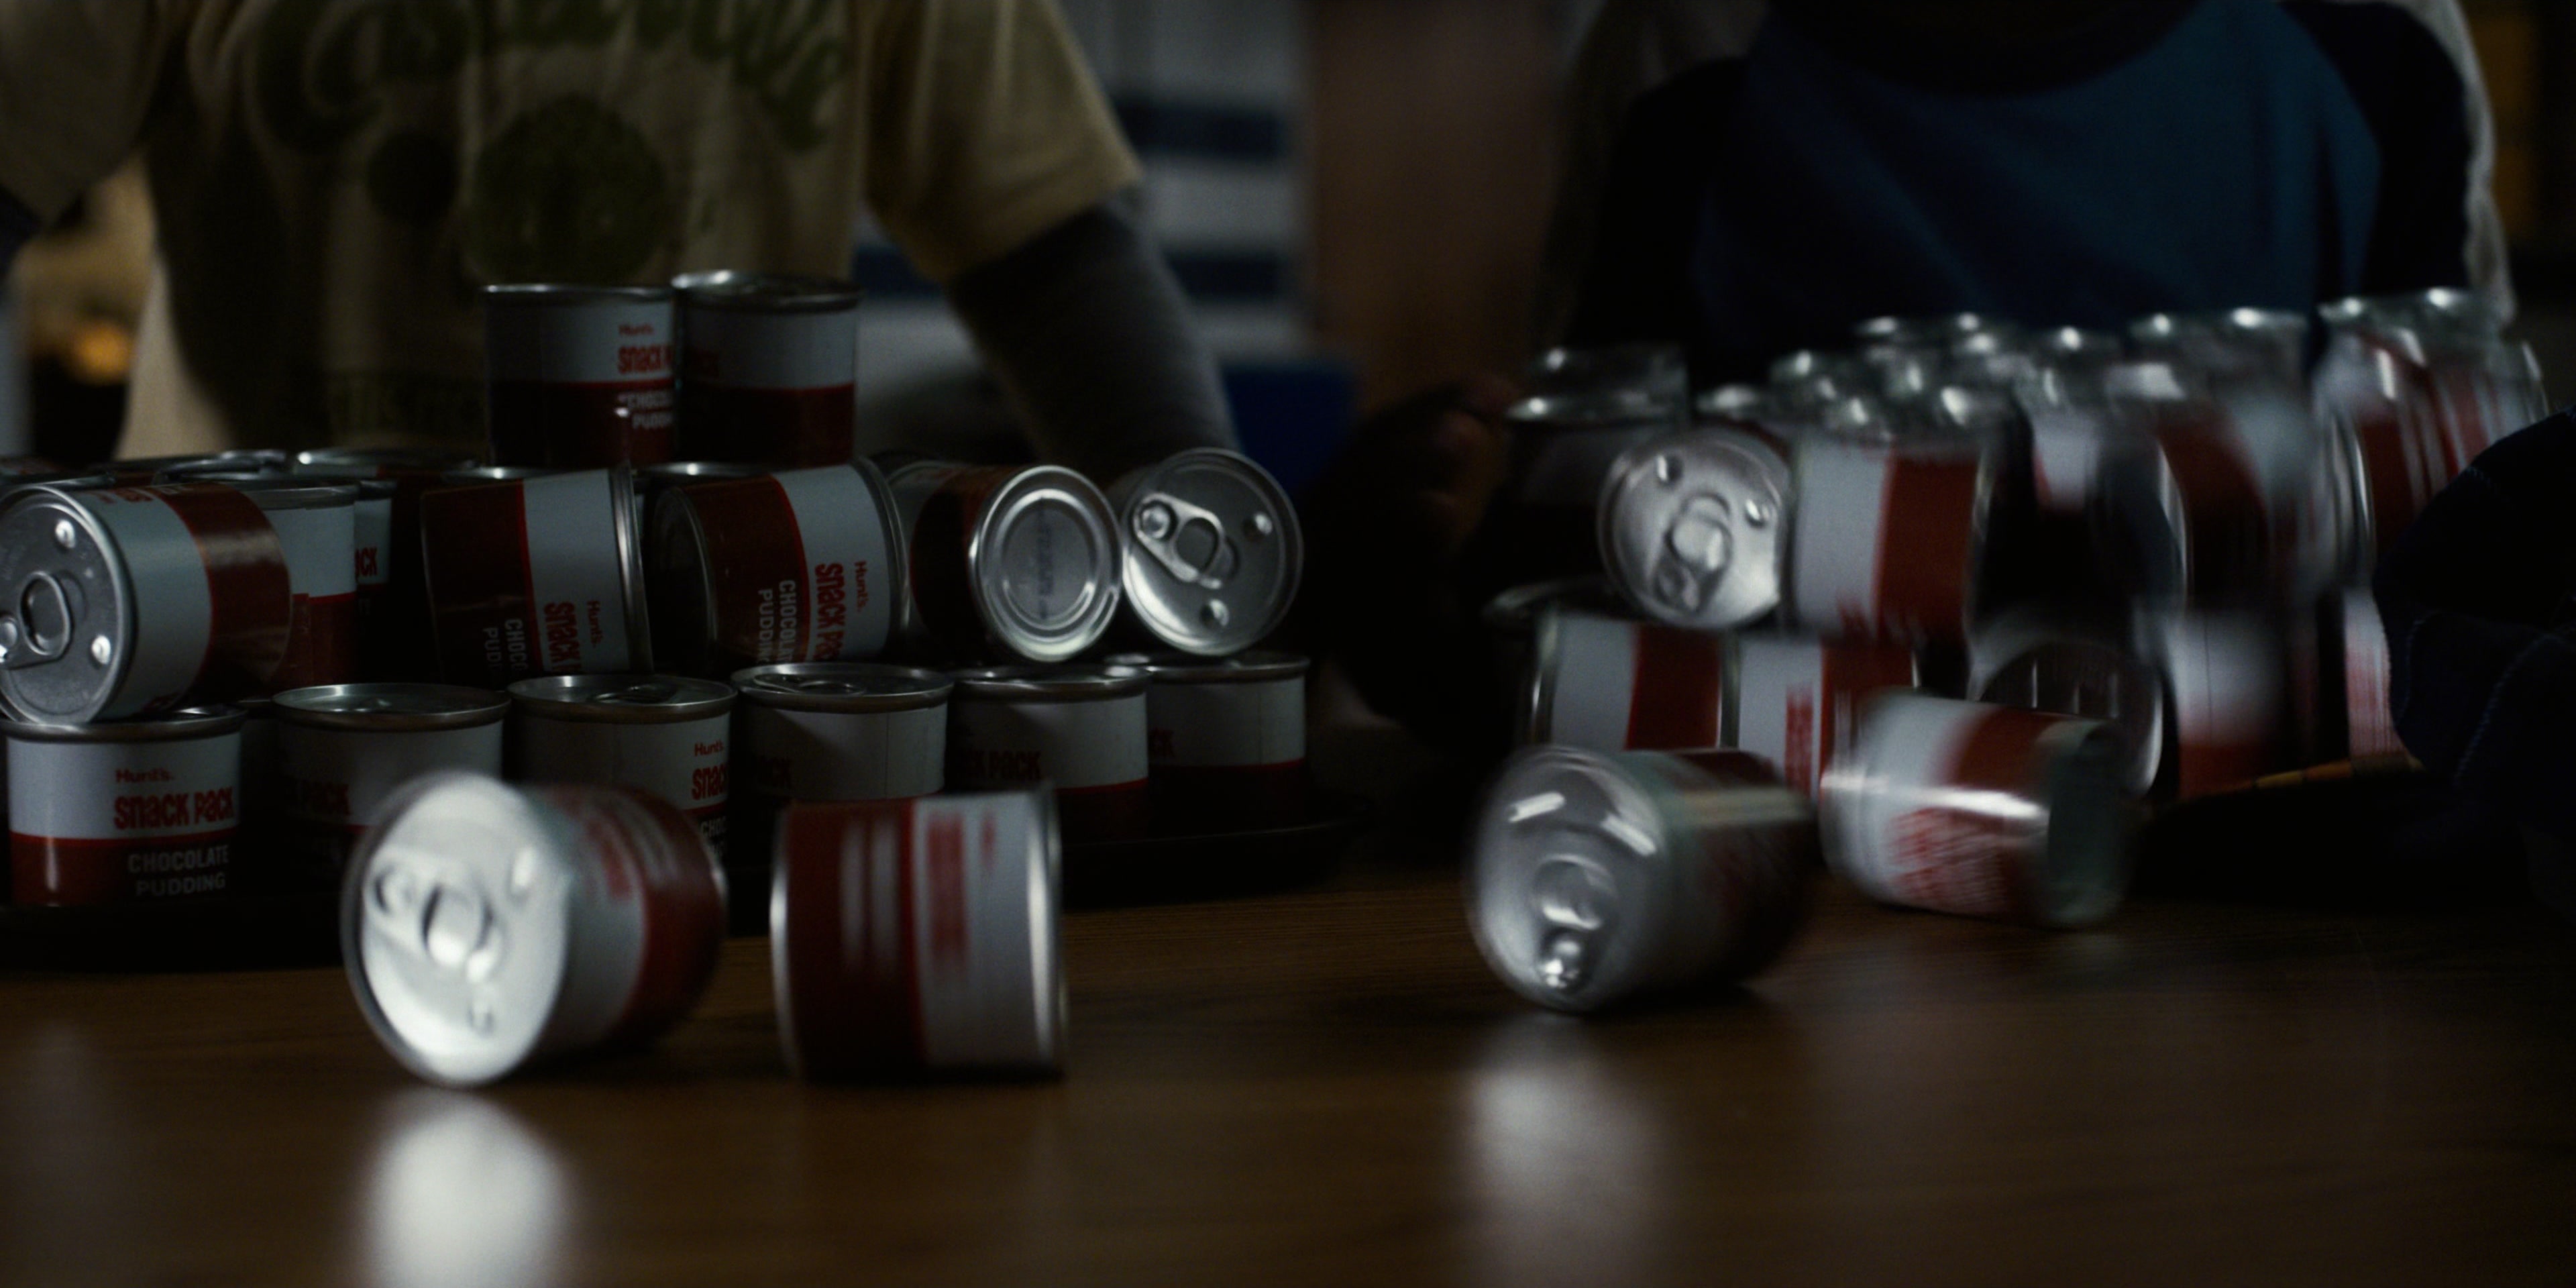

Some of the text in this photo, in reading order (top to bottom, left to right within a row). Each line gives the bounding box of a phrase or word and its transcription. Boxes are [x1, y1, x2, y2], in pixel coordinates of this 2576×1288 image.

[777, 579, 798, 661] CHOCOLAT
[127, 844, 231, 875] CHOCOLATE
[135, 871, 227, 897] PUDDING
